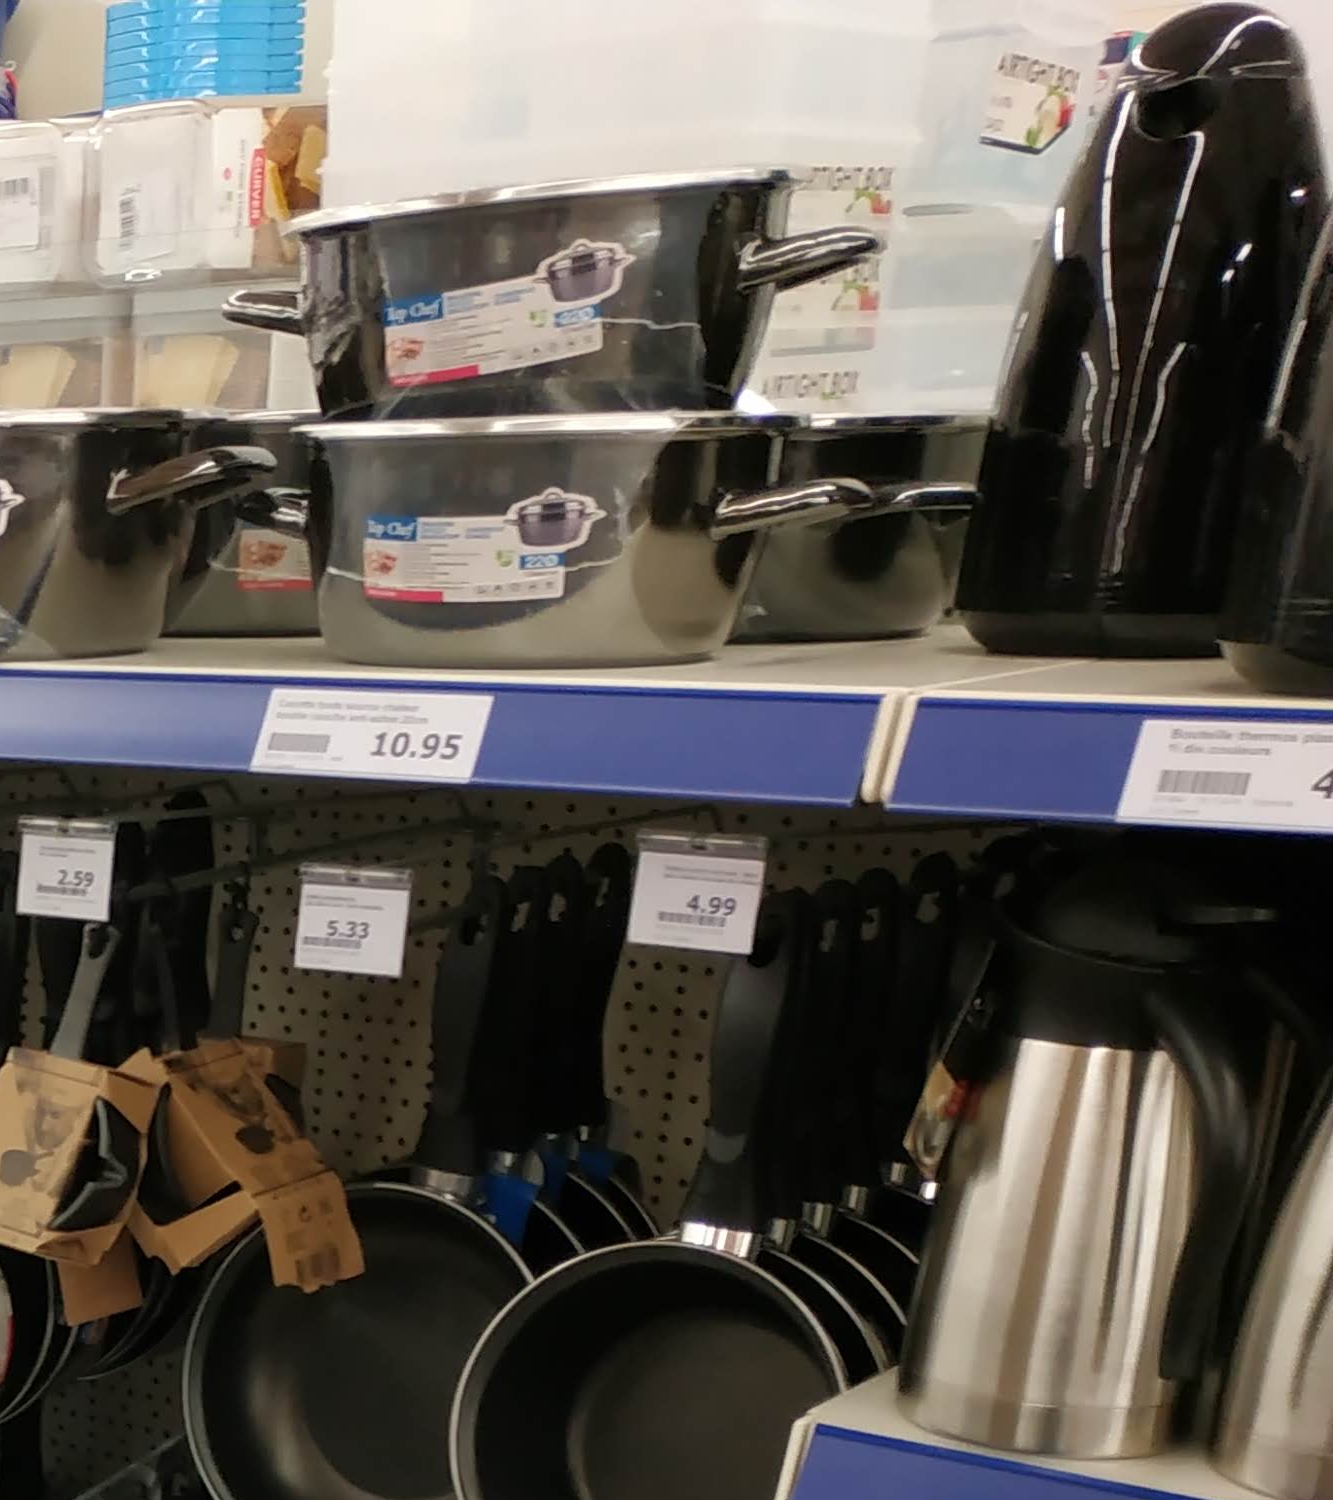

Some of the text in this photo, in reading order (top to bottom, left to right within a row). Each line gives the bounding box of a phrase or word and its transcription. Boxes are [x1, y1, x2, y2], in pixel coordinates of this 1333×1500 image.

[252, 154, 263, 225] CURVER
[410, 296, 441, 321] Chef
[371, 731, 463, 761] 10.95
[58, 868, 95, 888] 2.59
[687, 894, 737, 917] 4.99
[326, 919, 371, 940] 5.33
